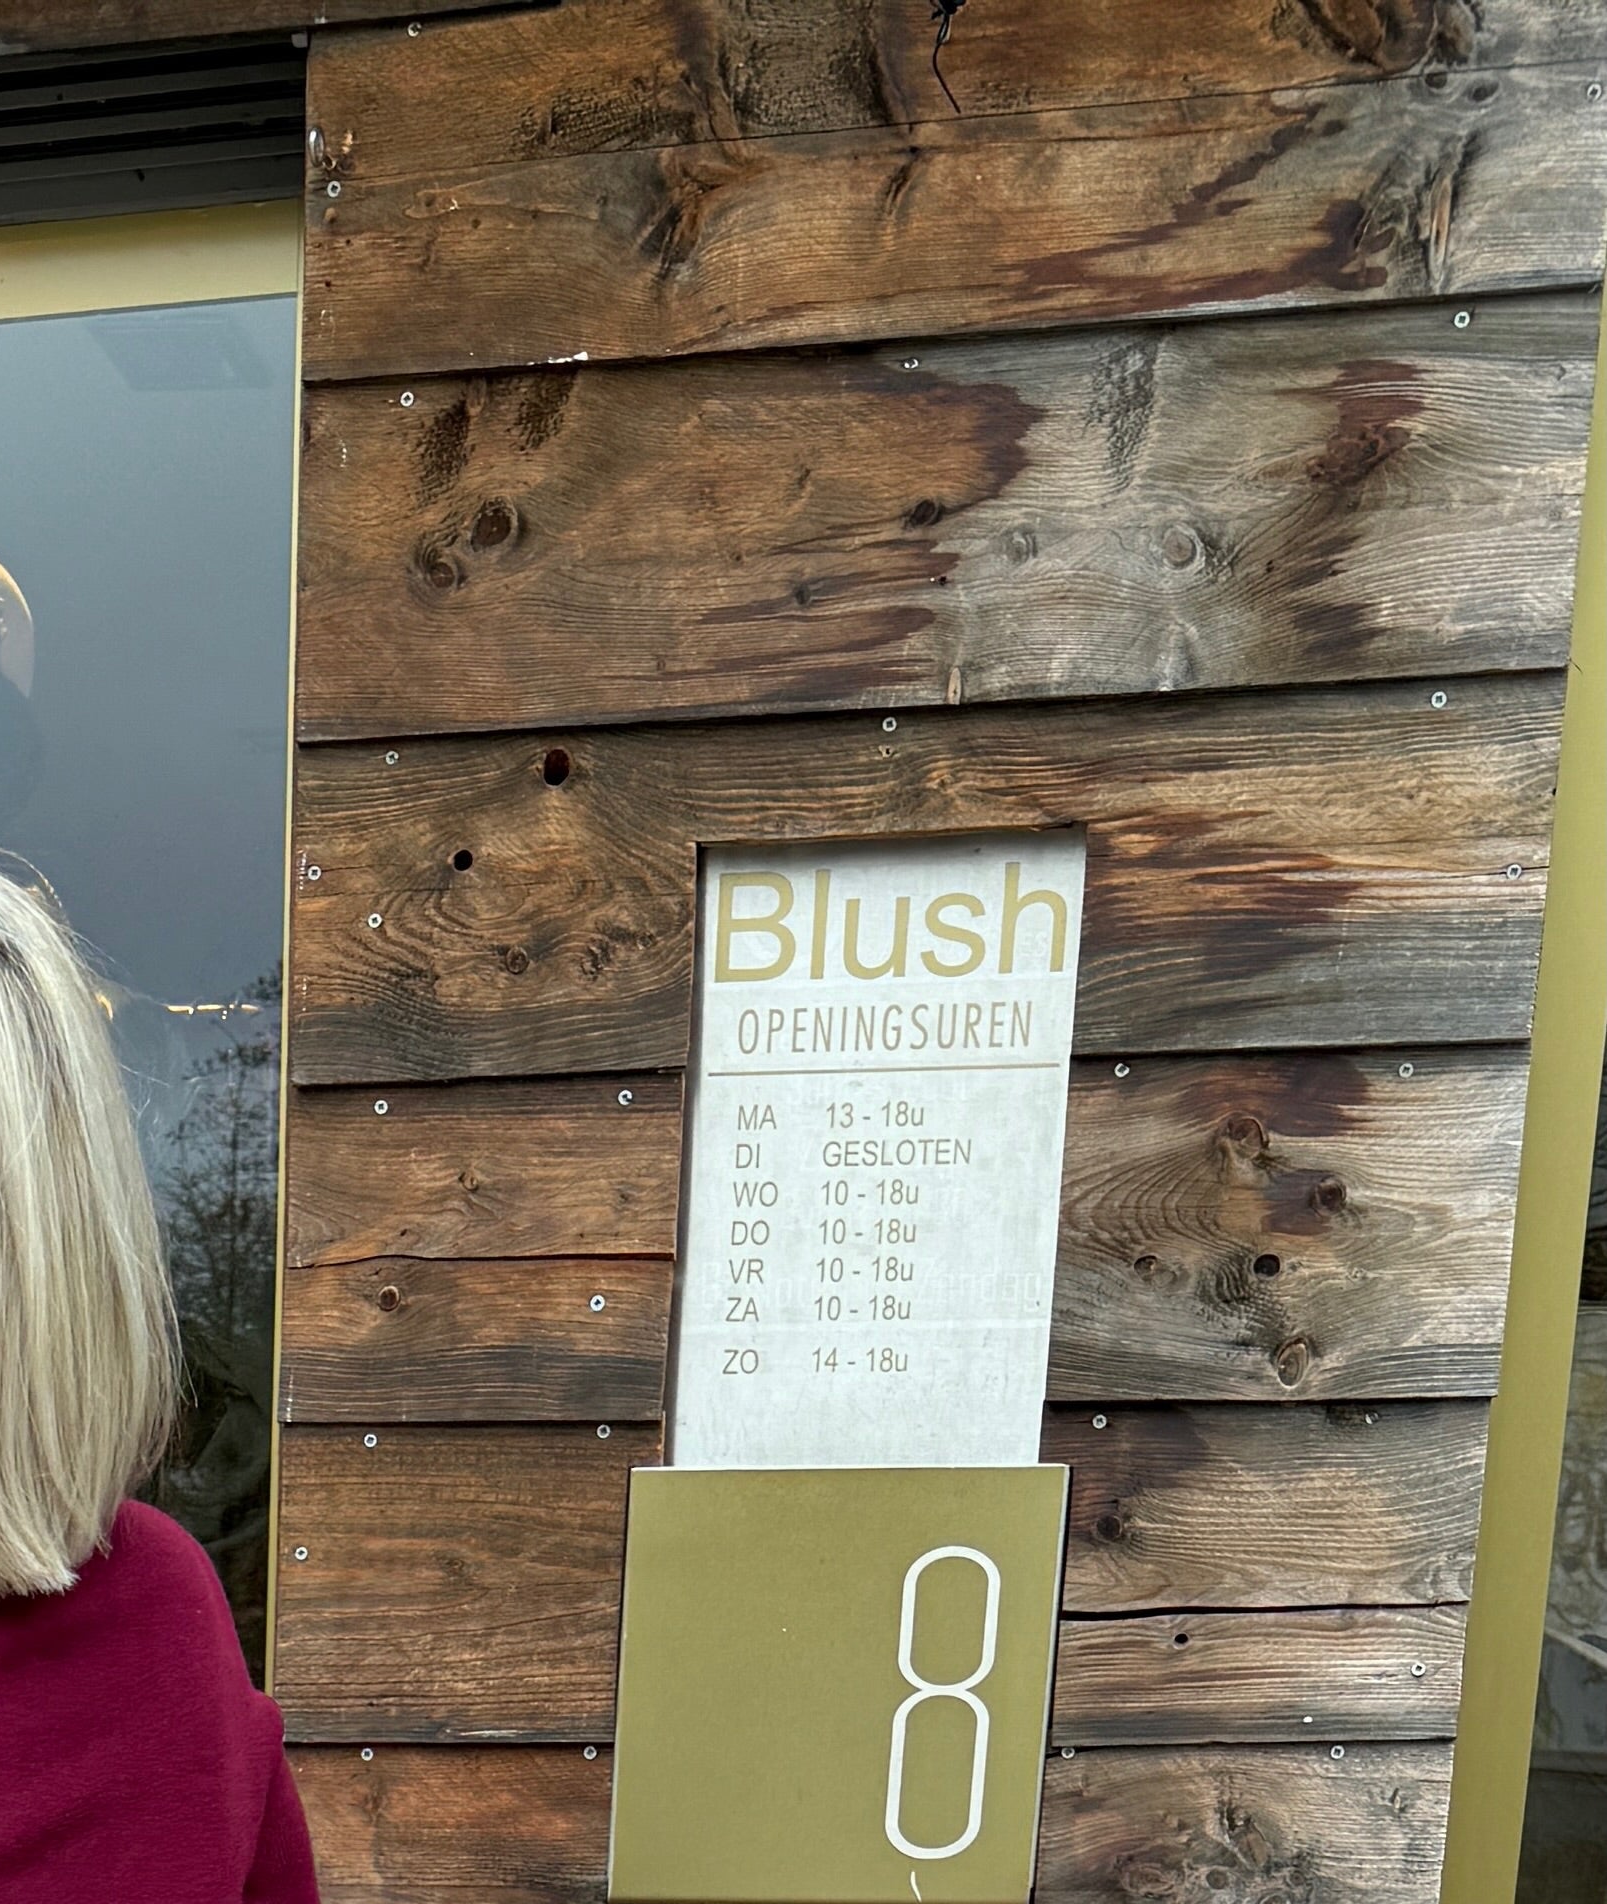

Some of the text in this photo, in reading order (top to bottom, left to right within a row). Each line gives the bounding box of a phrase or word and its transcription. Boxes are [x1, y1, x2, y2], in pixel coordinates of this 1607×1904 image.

[714, 861, 1066, 983] Blush
[739, 1001, 1032, 1054] OPENINGSUREN
[738, 1104, 777, 1130] MA
[827, 1103, 853, 1128] 13
[882, 1101, 924, 1127] 18u
[736, 1139, 971, 1169] DI GESLOTEN
[733, 1181, 778, 1207] WO
[821, 1180, 848, 1206] 10
[876, 1179, 919, 1205] 18u
[731, 1220, 770, 1245] DO
[819, 1218, 846, 1245] 10
[874, 1219, 916, 1244] 18u
[729, 1259, 764, 1284] VR
[817, 1257, 843, 1282] 10
[872, 1256, 914, 1282] 18u
[725, 1297, 759, 1322] ZA
[815, 1296, 841, 1321] 10
[869, 1295, 911, 1320] 18u
[722, 1349, 759, 1374] ZO
[812, 1347, 838, 1372] 14
[867, 1348, 908, 1372] 18u
[885, 1545, 1001, 1859] 8
